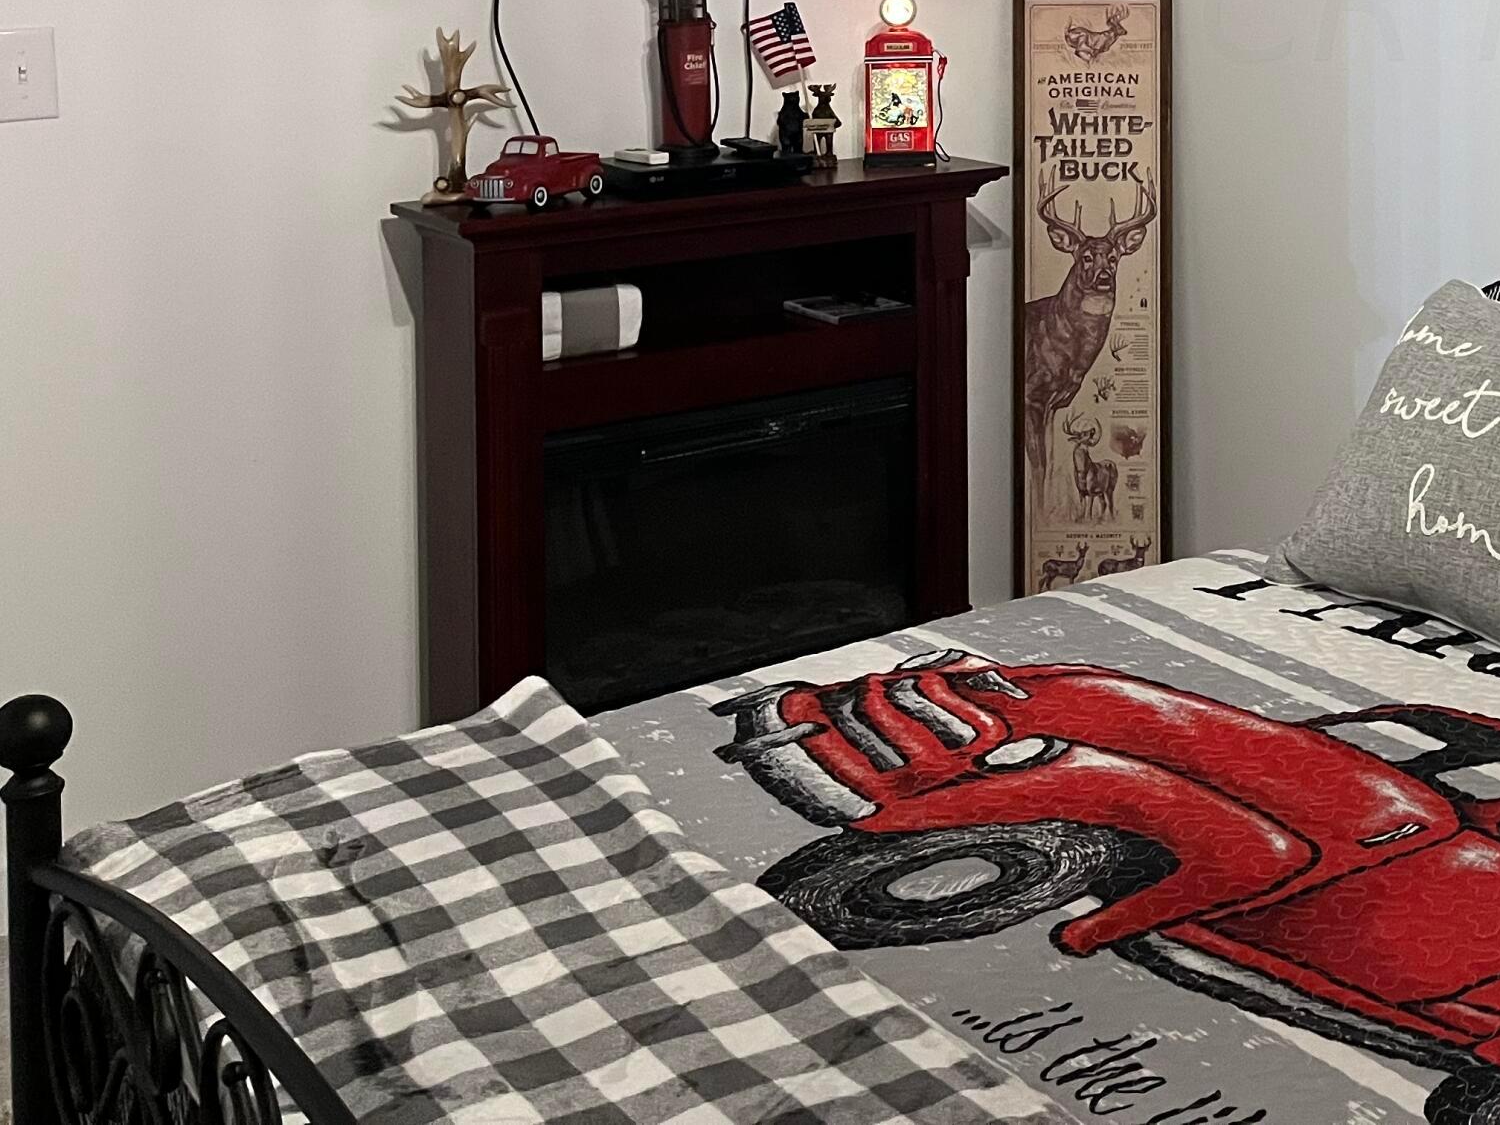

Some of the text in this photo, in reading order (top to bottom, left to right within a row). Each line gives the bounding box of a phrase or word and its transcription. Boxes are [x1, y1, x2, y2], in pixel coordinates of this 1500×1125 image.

[686, 54, 704, 62] Fire
[1048, 73, 1139, 85] AMERICAN
[1048, 86, 1136, 98] ORIGINAL
[1048, 107, 1153, 135] WHITE-
[889, 131, 911, 143] GAS
[1034, 136, 1133, 163] TAILED
[1059, 159, 1143, 183] BUCK
[1040, 1033, 1166, 1116] the
